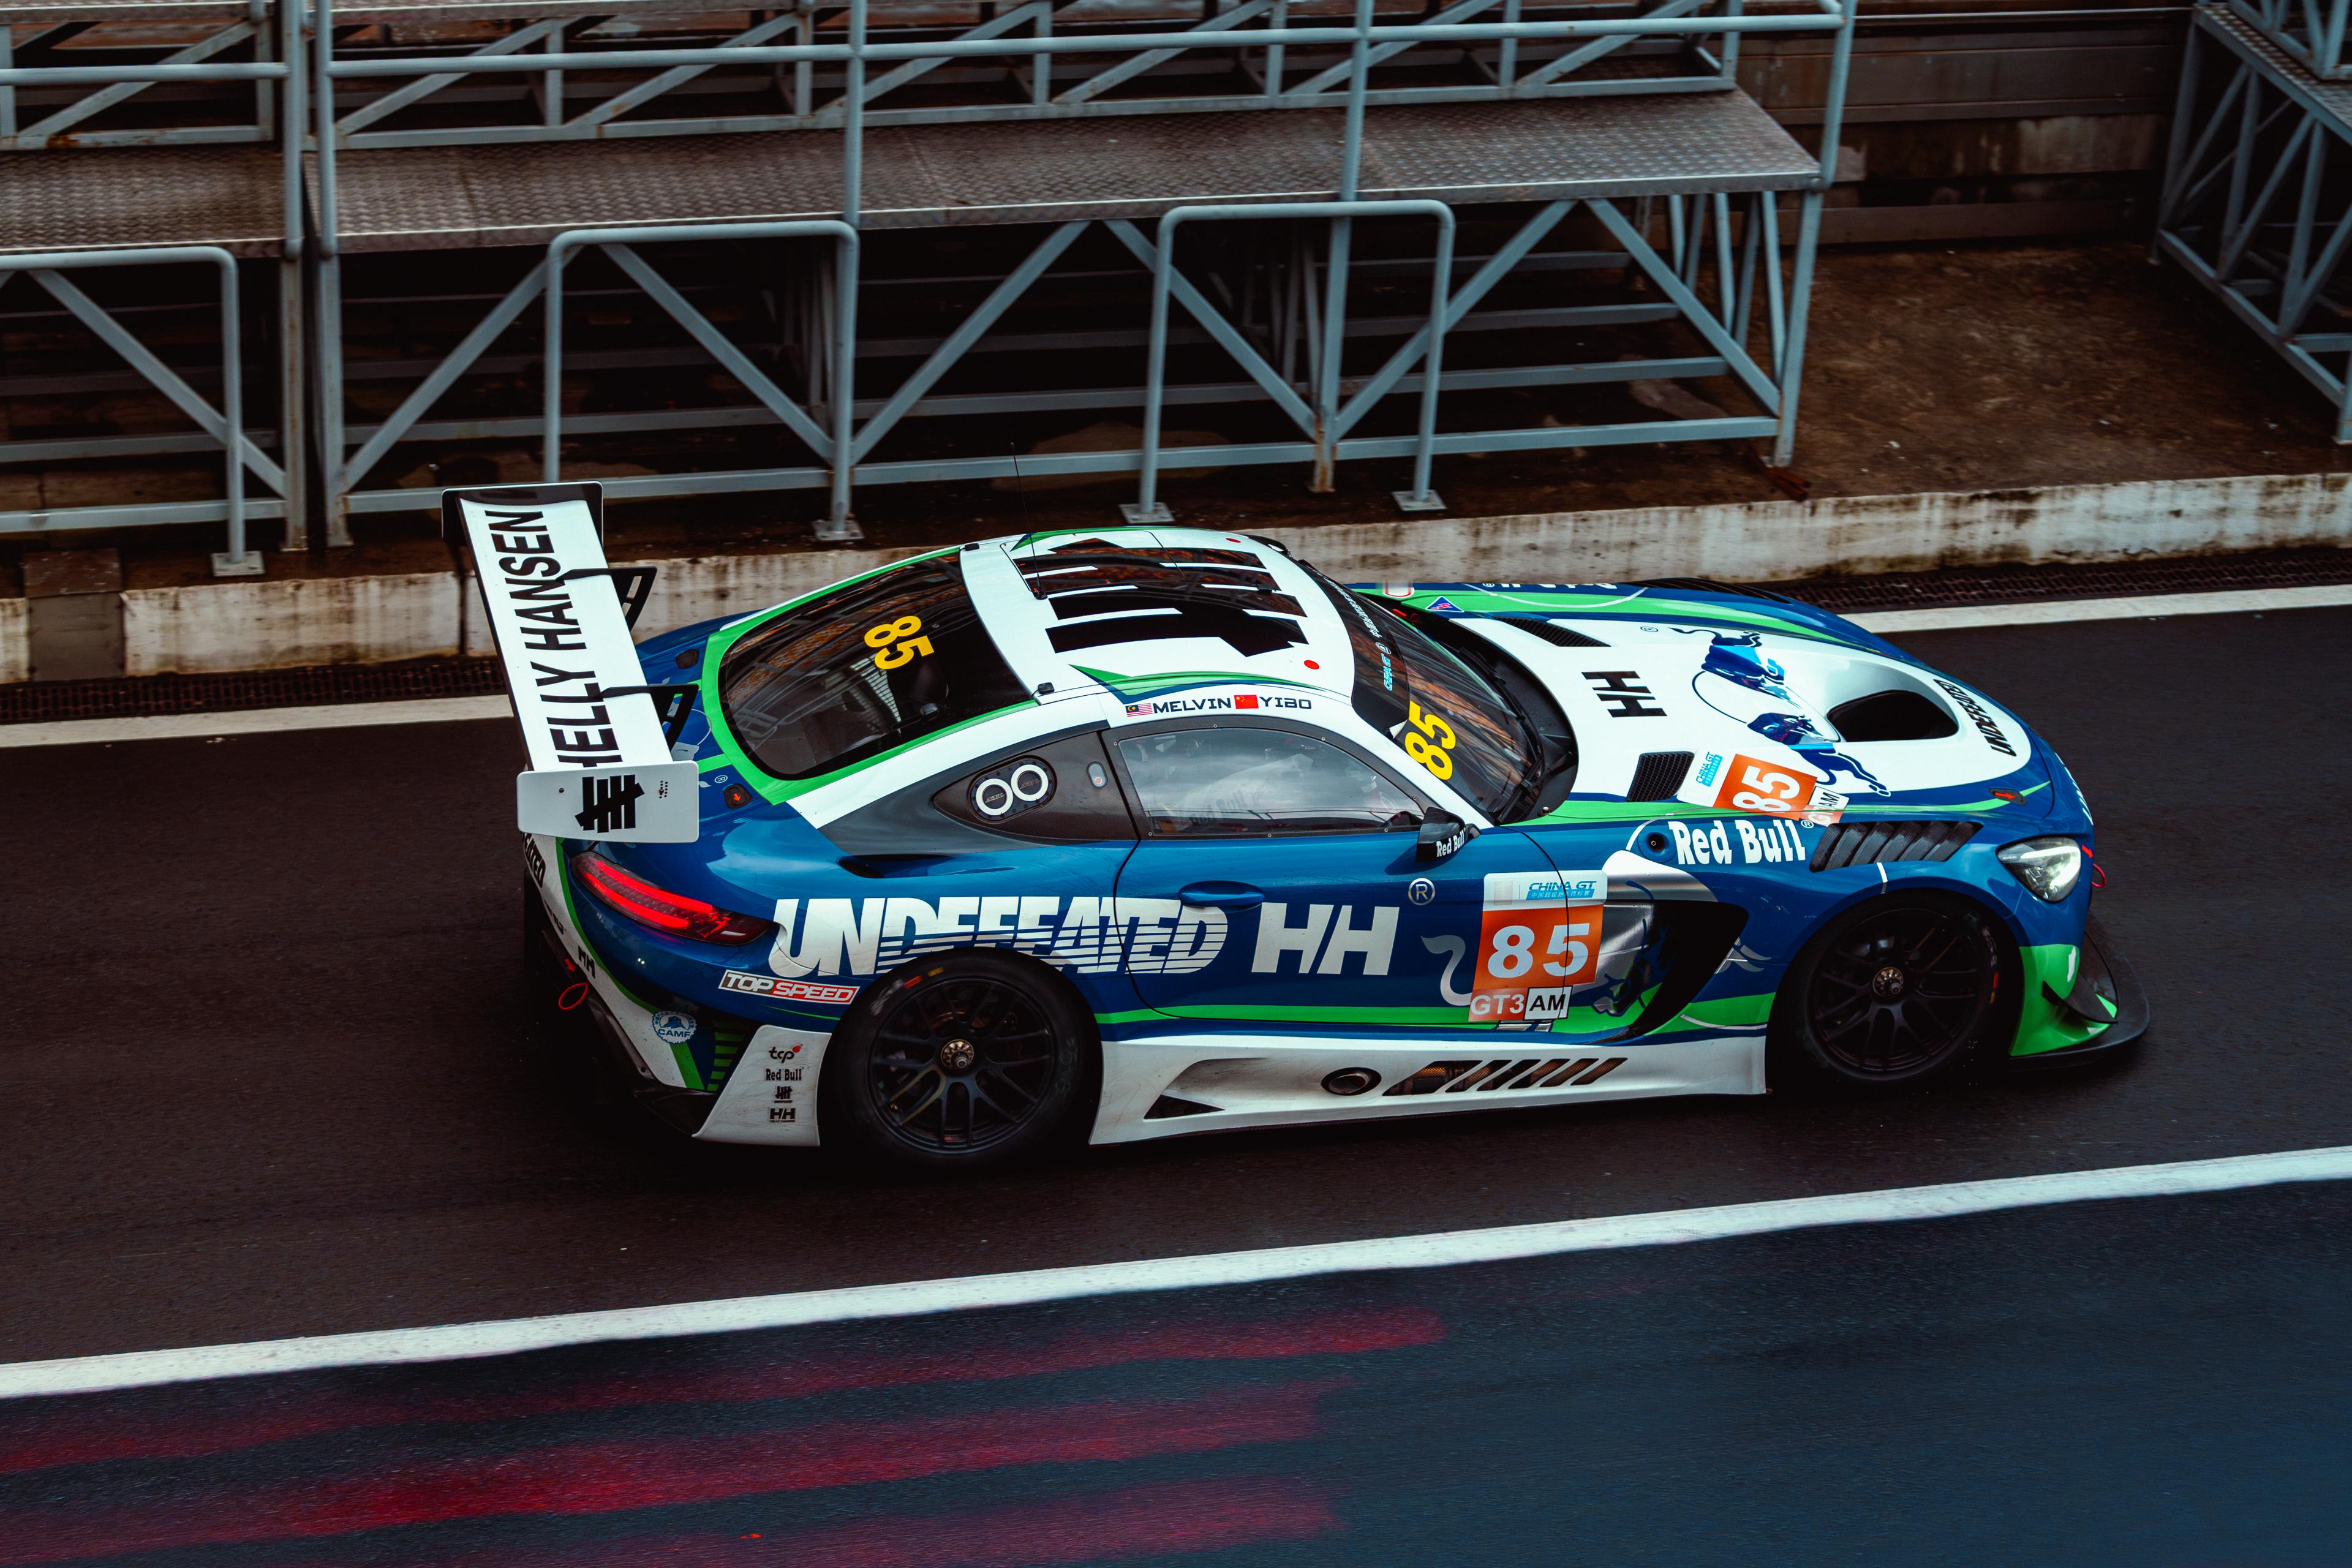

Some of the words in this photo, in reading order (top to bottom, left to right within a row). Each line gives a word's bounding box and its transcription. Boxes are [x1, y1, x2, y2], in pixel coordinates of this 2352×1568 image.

[484, 510, 587, 650] HANSEN
[864, 616, 935, 669] 85
[1153, 698, 1232, 714] MELVIN
[1259, 697, 1312, 710] YIBO
[1581, 671, 1667, 717] HH
[1404, 700, 1457, 780] 85
[1732, 765, 1800, 813] 85
[1819, 791, 1840, 809] AM
[1436, 837, 1452, 858] Red
[1453, 829, 1464, 852] Bull
[1668, 820, 1732, 865] Red
[1735, 820, 1806, 864] Bull
[1529, 881, 1572, 891] CHINA
[1576, 881, 1597, 890] GT
[768, 897, 1227, 978] UNDEFEATED
[1251, 902, 1400, 975] HH
[1488, 923, 1589, 978] 85
[727, 973, 774, 991] TOP
[774, 982, 853, 1001] SPEED
[1471, 990, 1525, 1014] GT3
[1529, 994, 1566, 1012] AM
[766, 1068, 781, 1080] Red
[785, 1068, 802, 1080] Bull
[770, 1107, 796, 1120] HH
